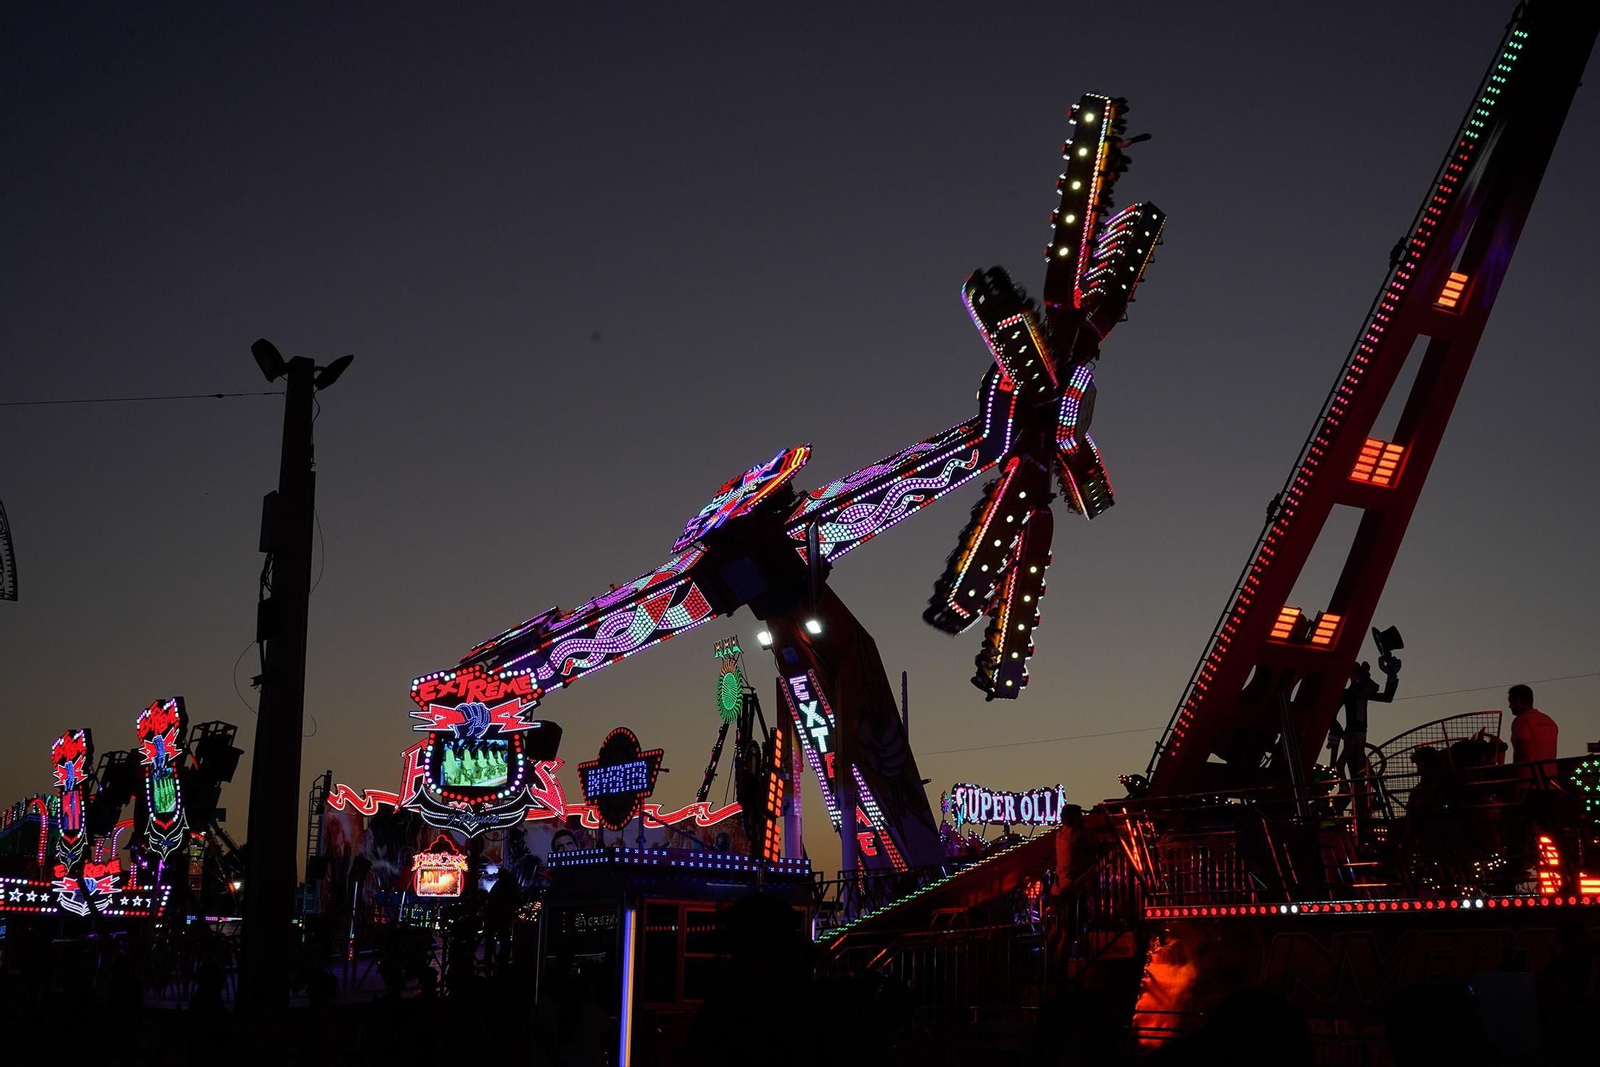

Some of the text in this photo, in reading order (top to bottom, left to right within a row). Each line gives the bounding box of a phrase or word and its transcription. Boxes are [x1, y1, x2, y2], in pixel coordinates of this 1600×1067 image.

[417, 671, 534, 703] EXTREME
[955, 787, 1017, 822] SUPER
[54, 859, 121, 878] EREME
